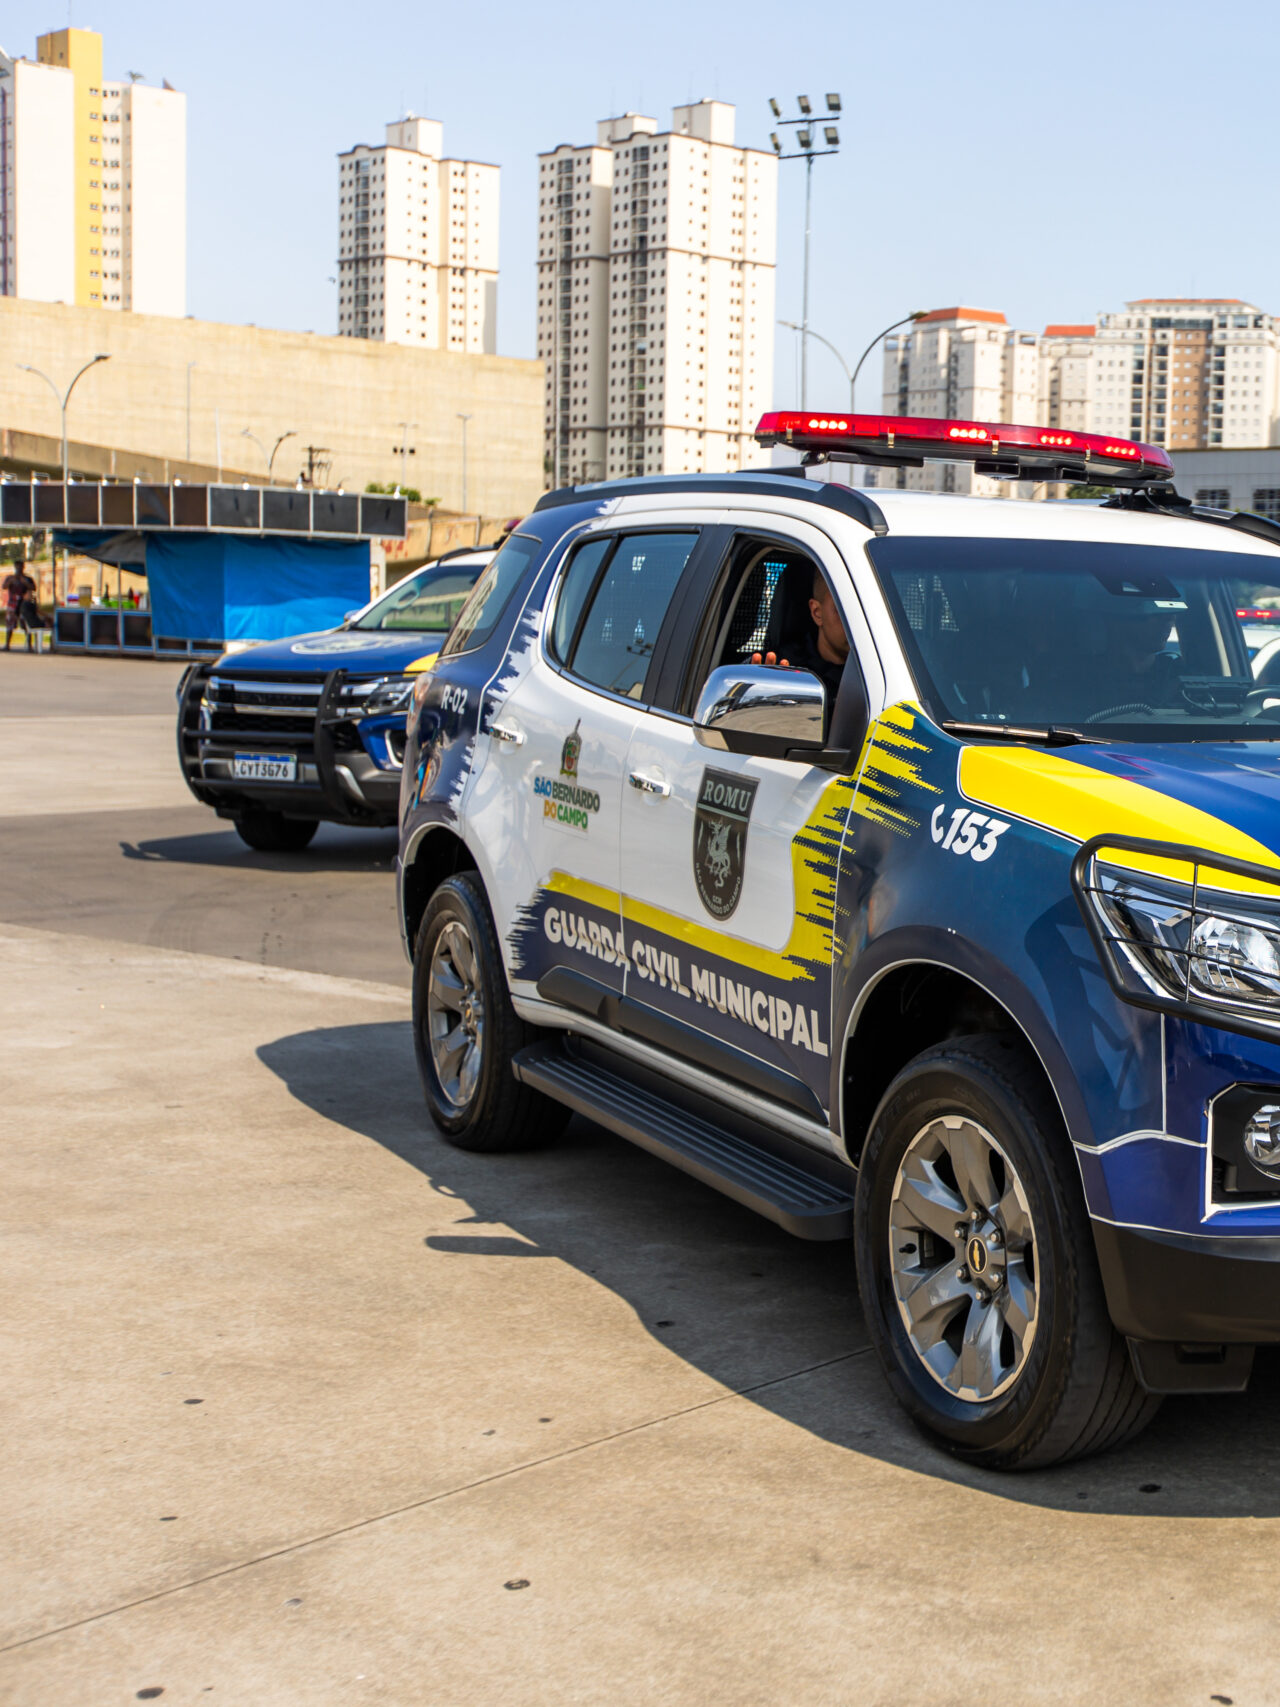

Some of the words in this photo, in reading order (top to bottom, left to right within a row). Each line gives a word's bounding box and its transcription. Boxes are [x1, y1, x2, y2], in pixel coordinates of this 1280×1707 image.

[441, 684, 468, 715] R-02
[240, 761, 289, 778] CYT3G76
[533, 776, 552, 797] SÃO
[552, 781, 600, 812] BERNARDO
[702, 780, 752, 812] ROMU
[544, 800, 556, 819] DO
[557, 803, 588, 829] CAMPO
[941, 808, 1012, 862] 153
[544, 907, 631, 972] GUARDA
[632, 939, 691, 999] CIVIL
[691, 963, 829, 1058] MUNICIPAL
